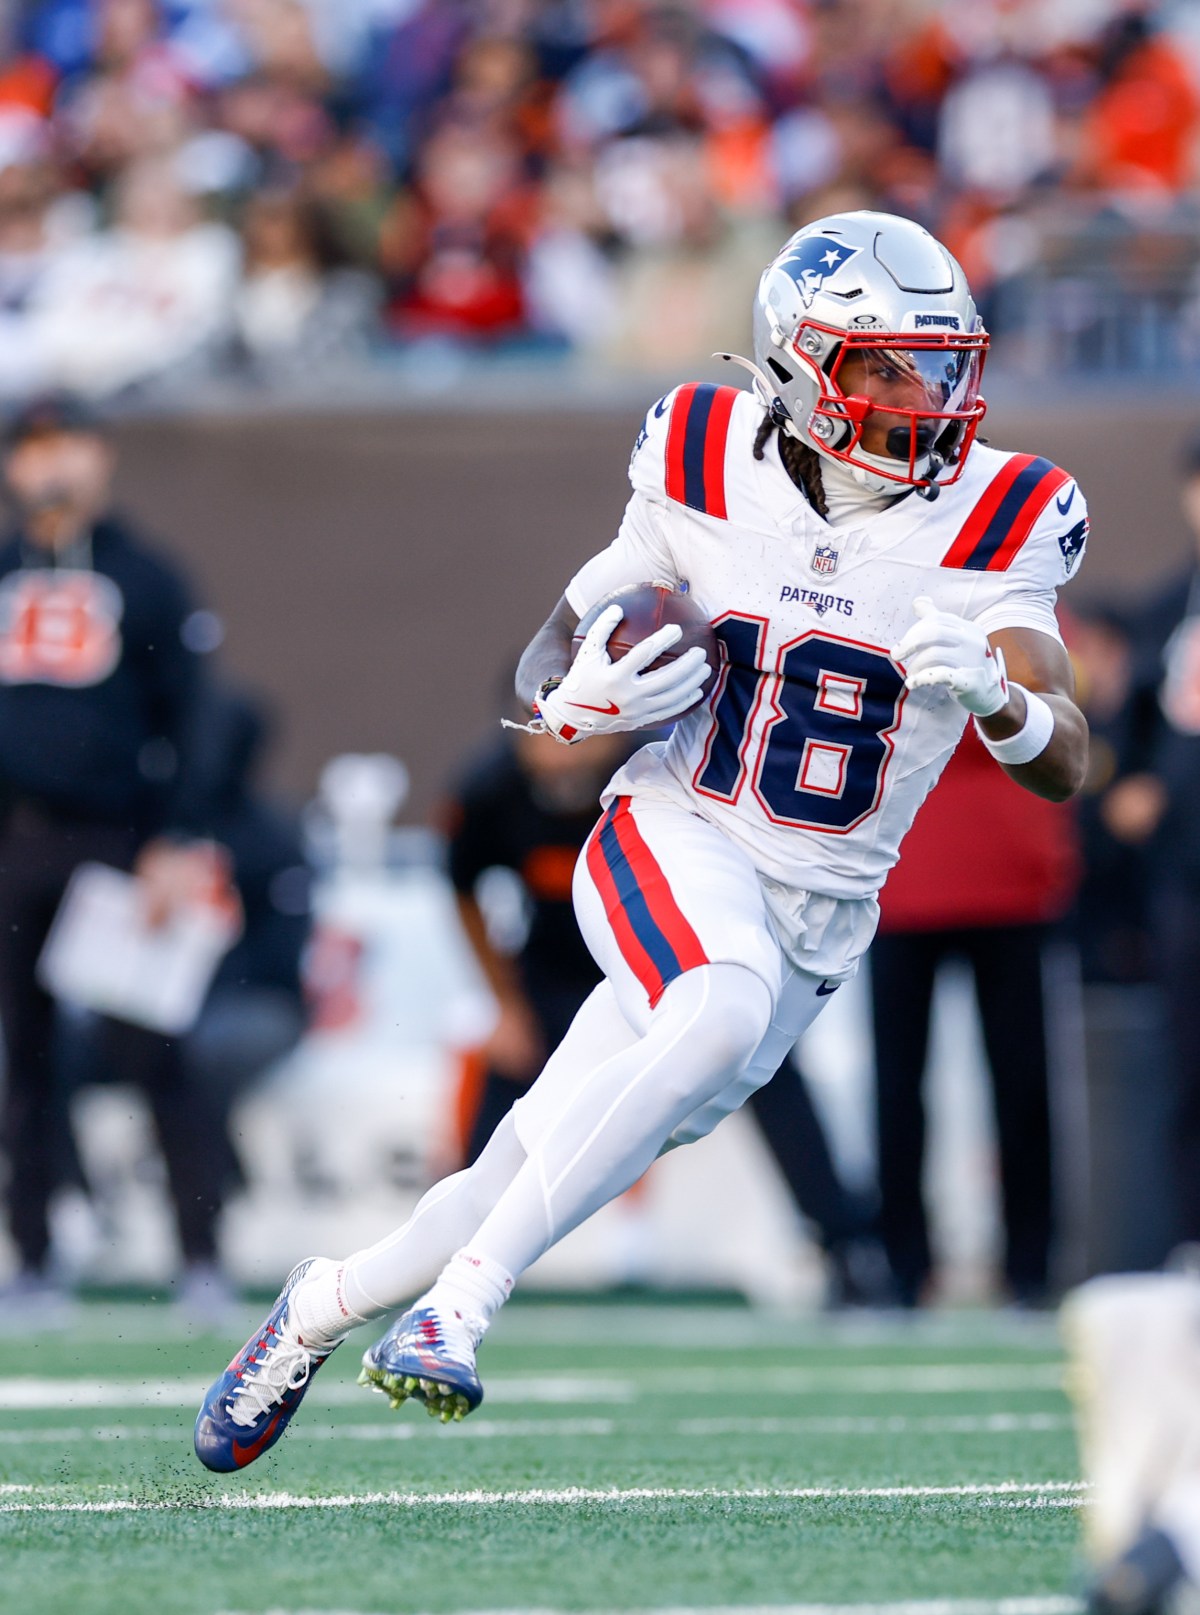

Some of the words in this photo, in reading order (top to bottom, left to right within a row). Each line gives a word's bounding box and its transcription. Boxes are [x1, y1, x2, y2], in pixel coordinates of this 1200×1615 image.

[914, 314, 959, 331] PATRIOTS
[814, 557, 833, 572] NFL
[779, 586, 854, 616] PATRIOTS
[693, 609, 908, 835] 18
